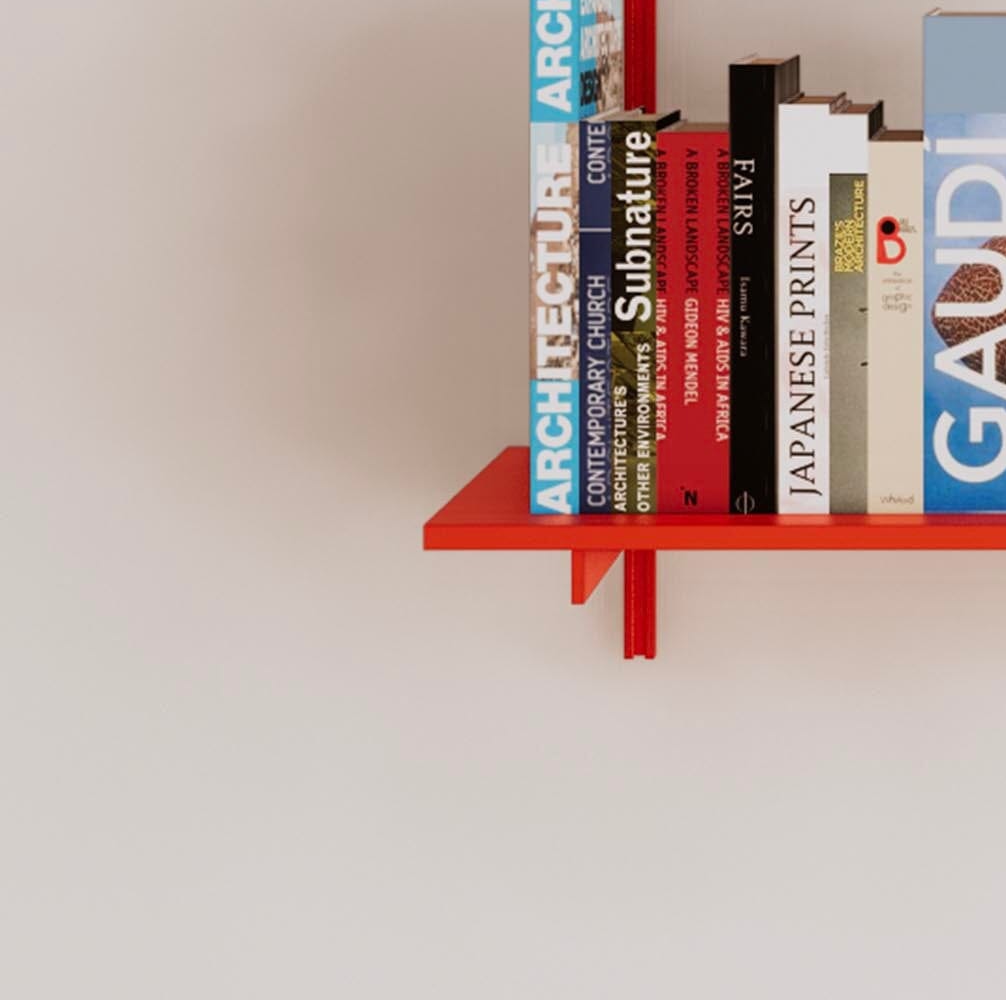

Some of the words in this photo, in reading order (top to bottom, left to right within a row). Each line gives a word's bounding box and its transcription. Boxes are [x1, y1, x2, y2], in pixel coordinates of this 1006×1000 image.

[587, 120, 606, 184] CONTE
[686, 148, 698, 158] A
[717, 148, 730, 158] A
[686, 161, 698, 214] BROKEN
[717, 161, 730, 214] BROKEN
[733, 159, 755, 235] FAIRS
[614, 131, 651, 322] Subnature
[686, 218, 698, 293] LANDSCAPE
[717, 218, 730, 293] LANDSCAPE
[789, 197, 816, 319] PRINTS
[854, 179, 865, 273] ARCHITECTURE
[536, 143, 572, 514] ARCHITECTURE
[587, 275, 606, 351] CHURCH
[684, 297, 698, 349] GIDEON
[716, 298, 730, 324] HIV
[716, 326, 730, 336] &
[684, 352, 698, 405] MENDEL
[716, 340, 730, 371] AIDS
[716, 375, 730, 390] IN
[587, 356, 606, 507] CONTEMPORARY
[637, 343, 651, 457] ENVIRONMENTS
[716, 392, 730, 441] AFRICA
[789, 329, 823, 496] JAPANESE
[614, 385, 627, 512] ARCHITECTURE'S
[637, 463, 651, 512] OTHER
